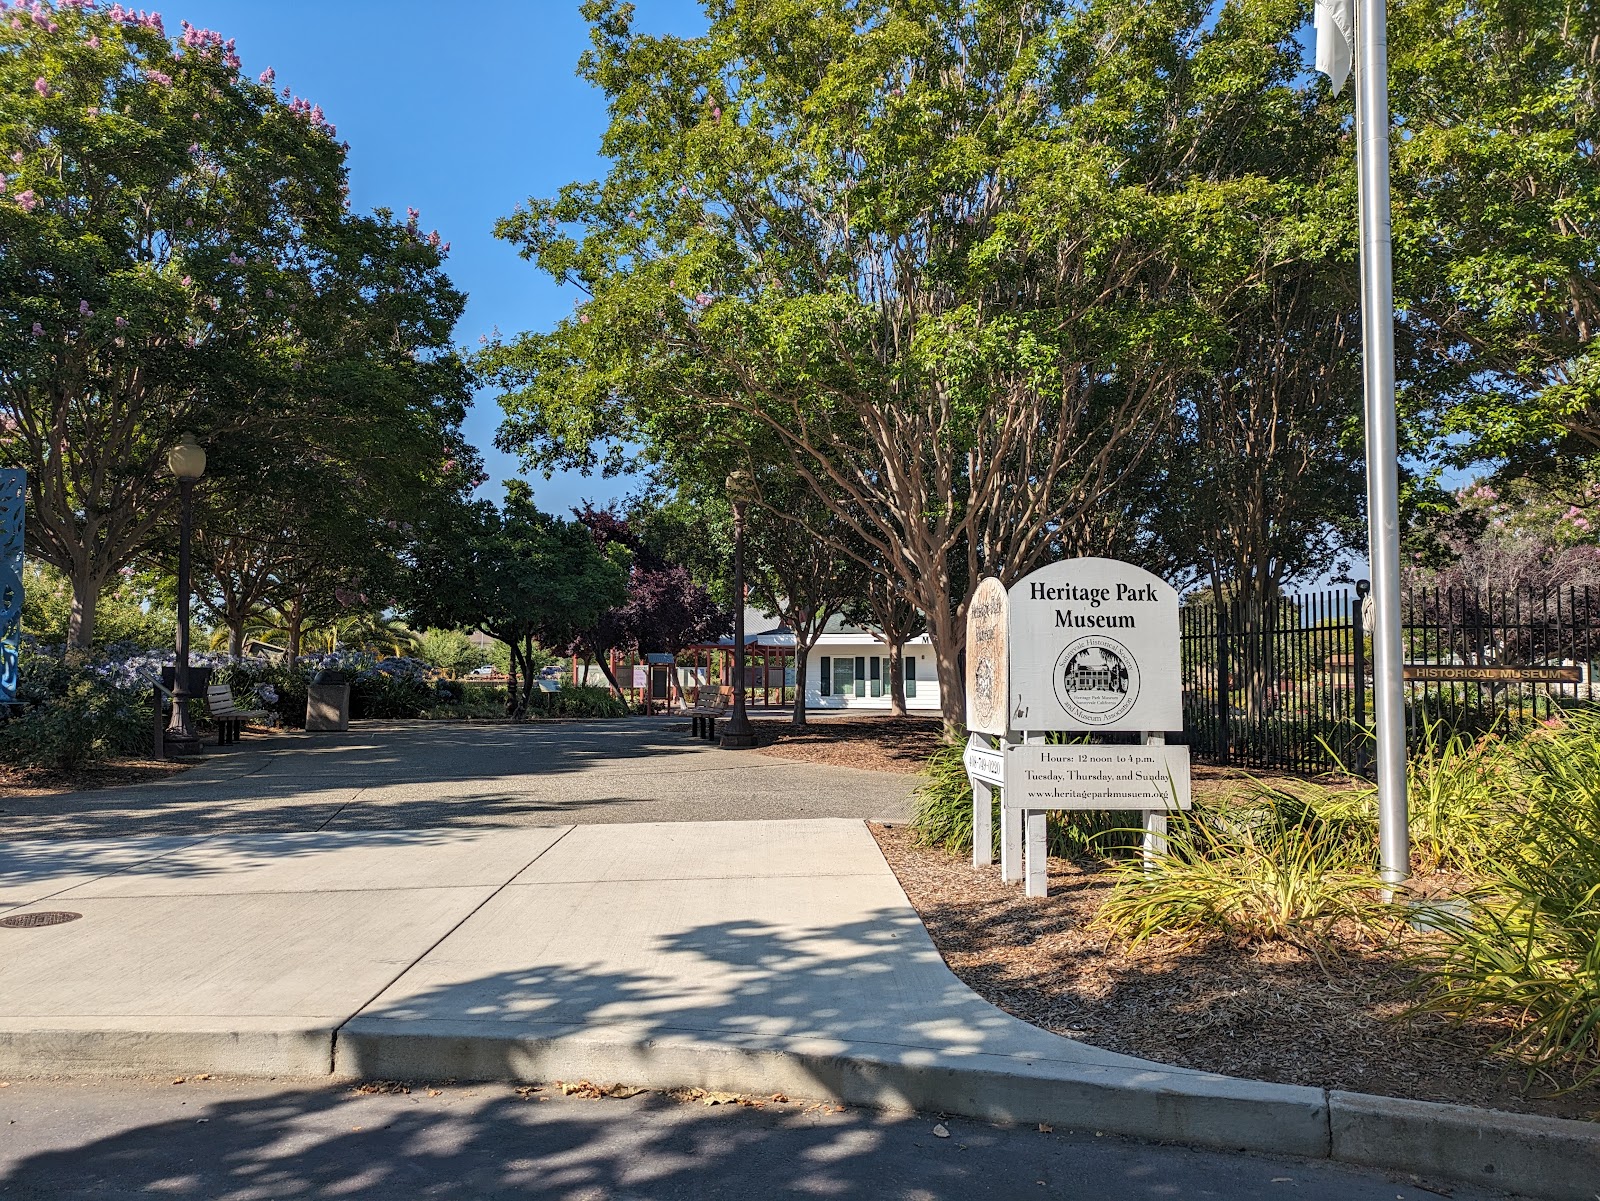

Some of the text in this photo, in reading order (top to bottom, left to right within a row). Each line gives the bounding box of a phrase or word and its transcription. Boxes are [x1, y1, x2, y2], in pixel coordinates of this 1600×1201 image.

[1030, 582, 1159, 608] Heritage Park
[1055, 609, 1136, 628] Museum
[1059, 639, 1134, 671] Sunnyvale Historical Society
[1416, 668, 1561, 679] HISTORICAL MUSEUM
[1064, 697, 1133, 722] and Museum Association
[1041, 752, 1074, 763] Hours:
[1078, 754, 1088, 763] 12
[1116, 755, 1126, 763] to
[1128, 754, 1133, 763] 4
[1135, 756, 1155, 765] p.m.
[1024, 769, 1169, 782] Tuesday, Thursday, and Sunday
